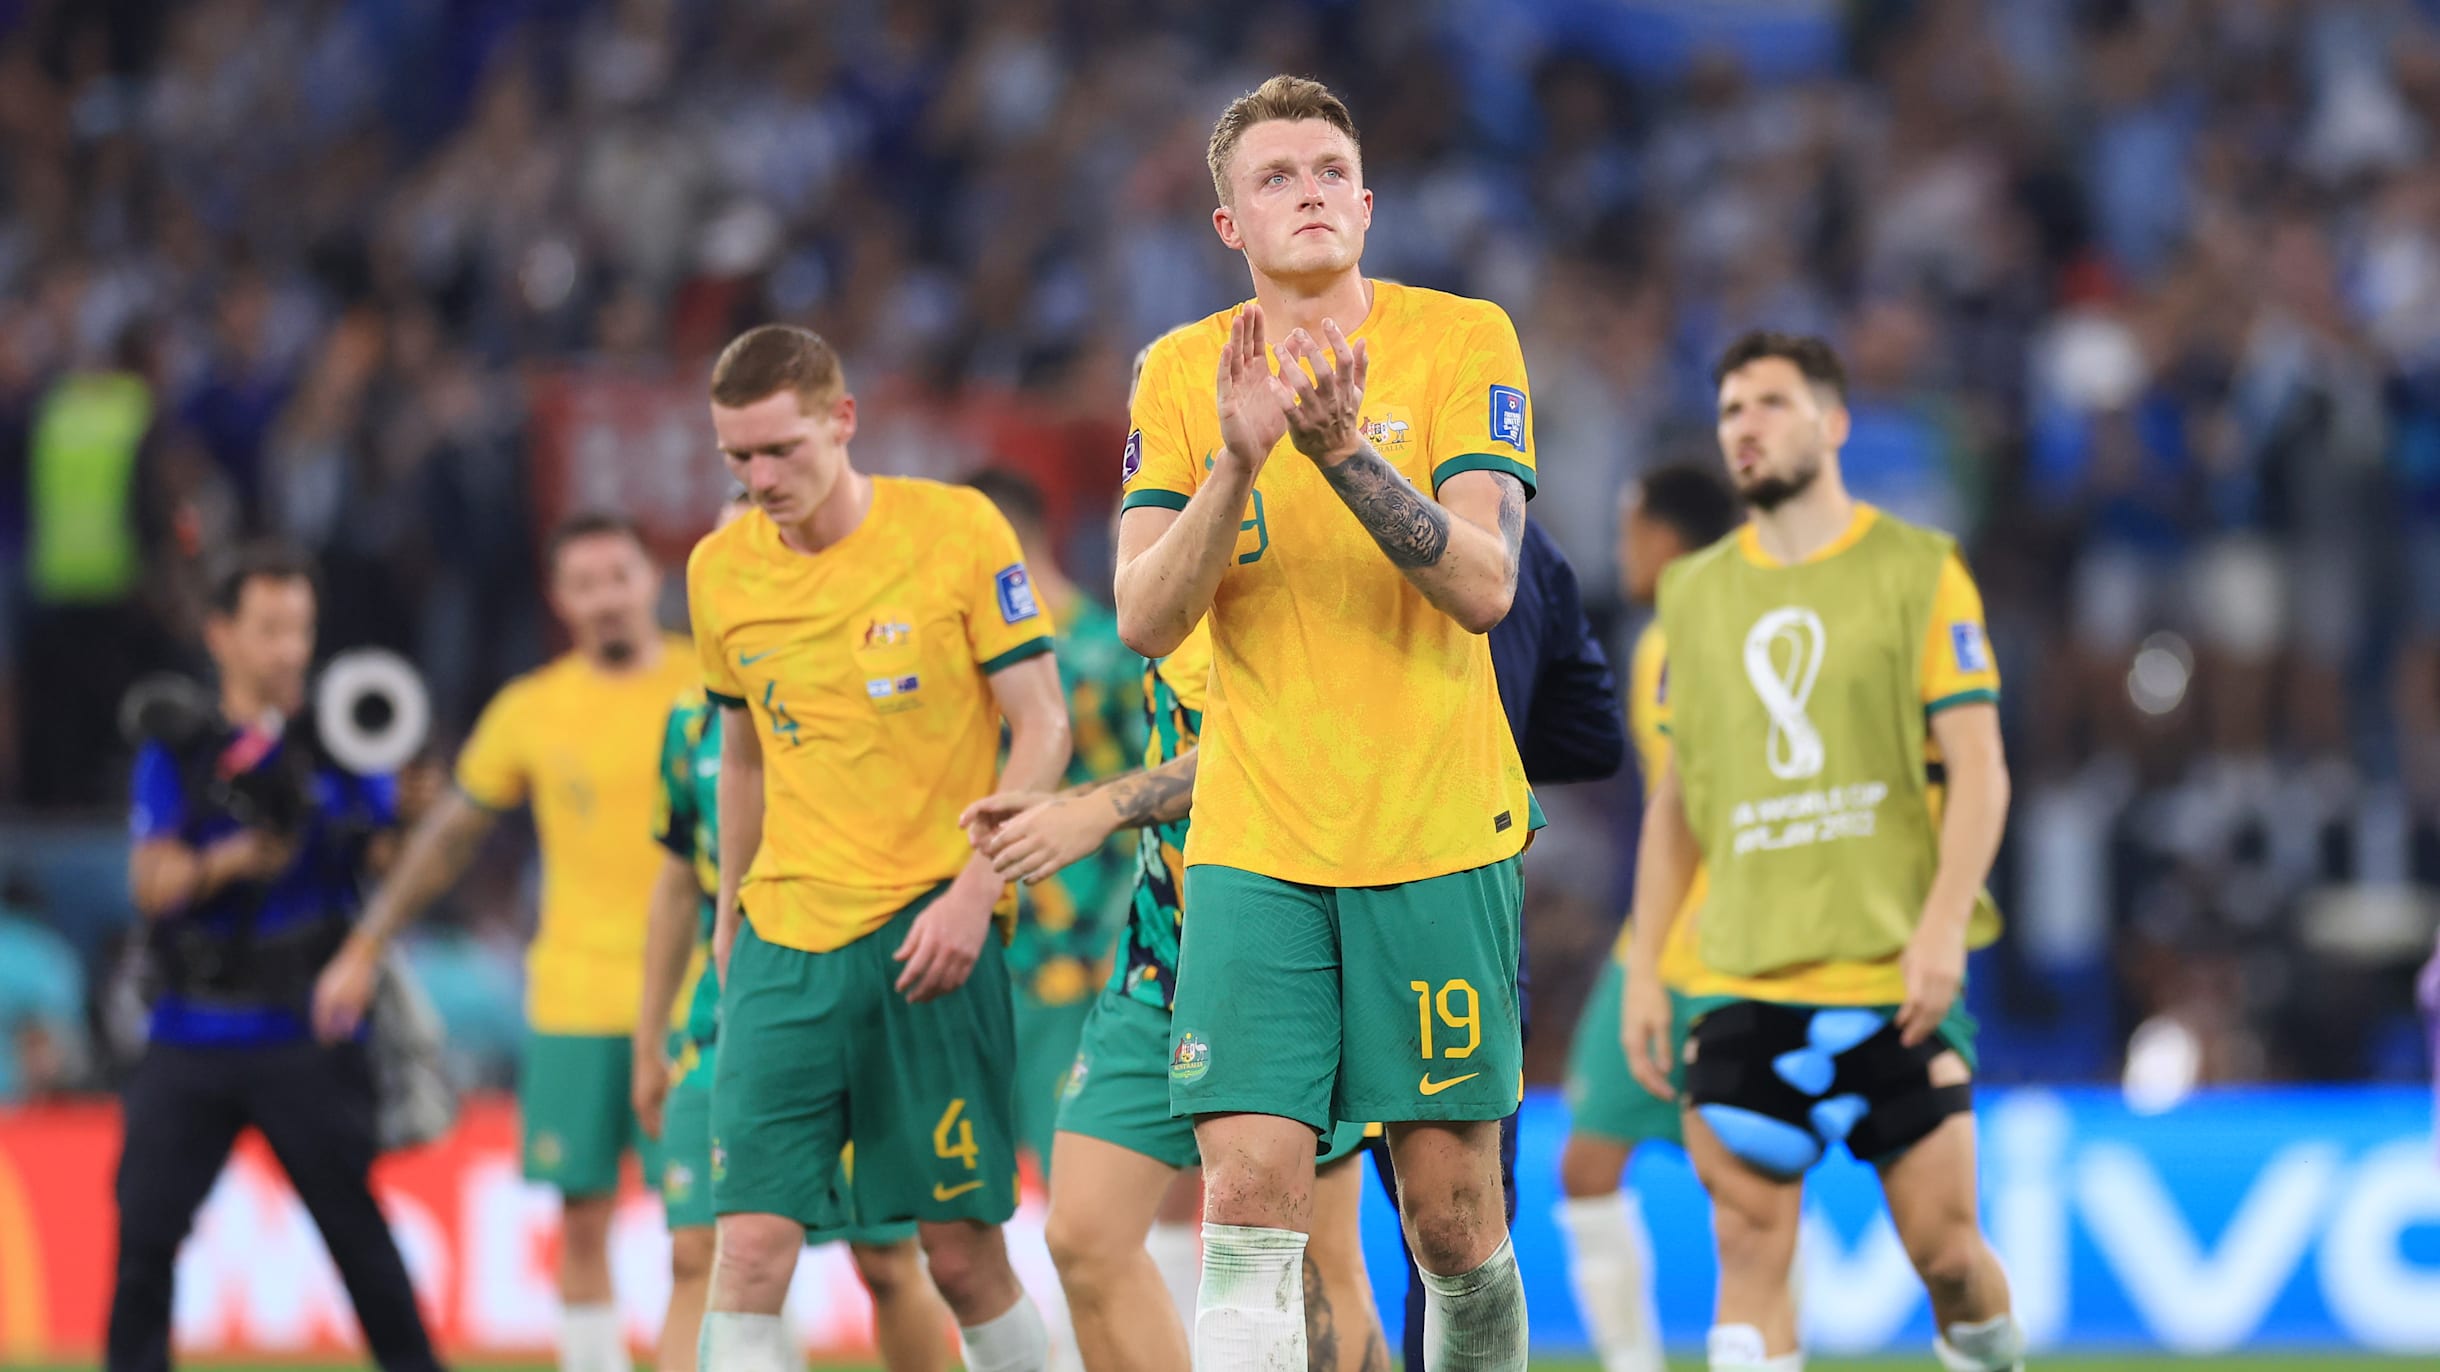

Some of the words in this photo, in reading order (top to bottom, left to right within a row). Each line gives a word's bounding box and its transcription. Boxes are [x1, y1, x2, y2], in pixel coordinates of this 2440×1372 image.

[1378, 444, 1405, 453] RALIA
[1239, 487, 1269, 565] 9
[1410, 978, 1481, 1059] 19
[933, 1098, 979, 1169] 4
